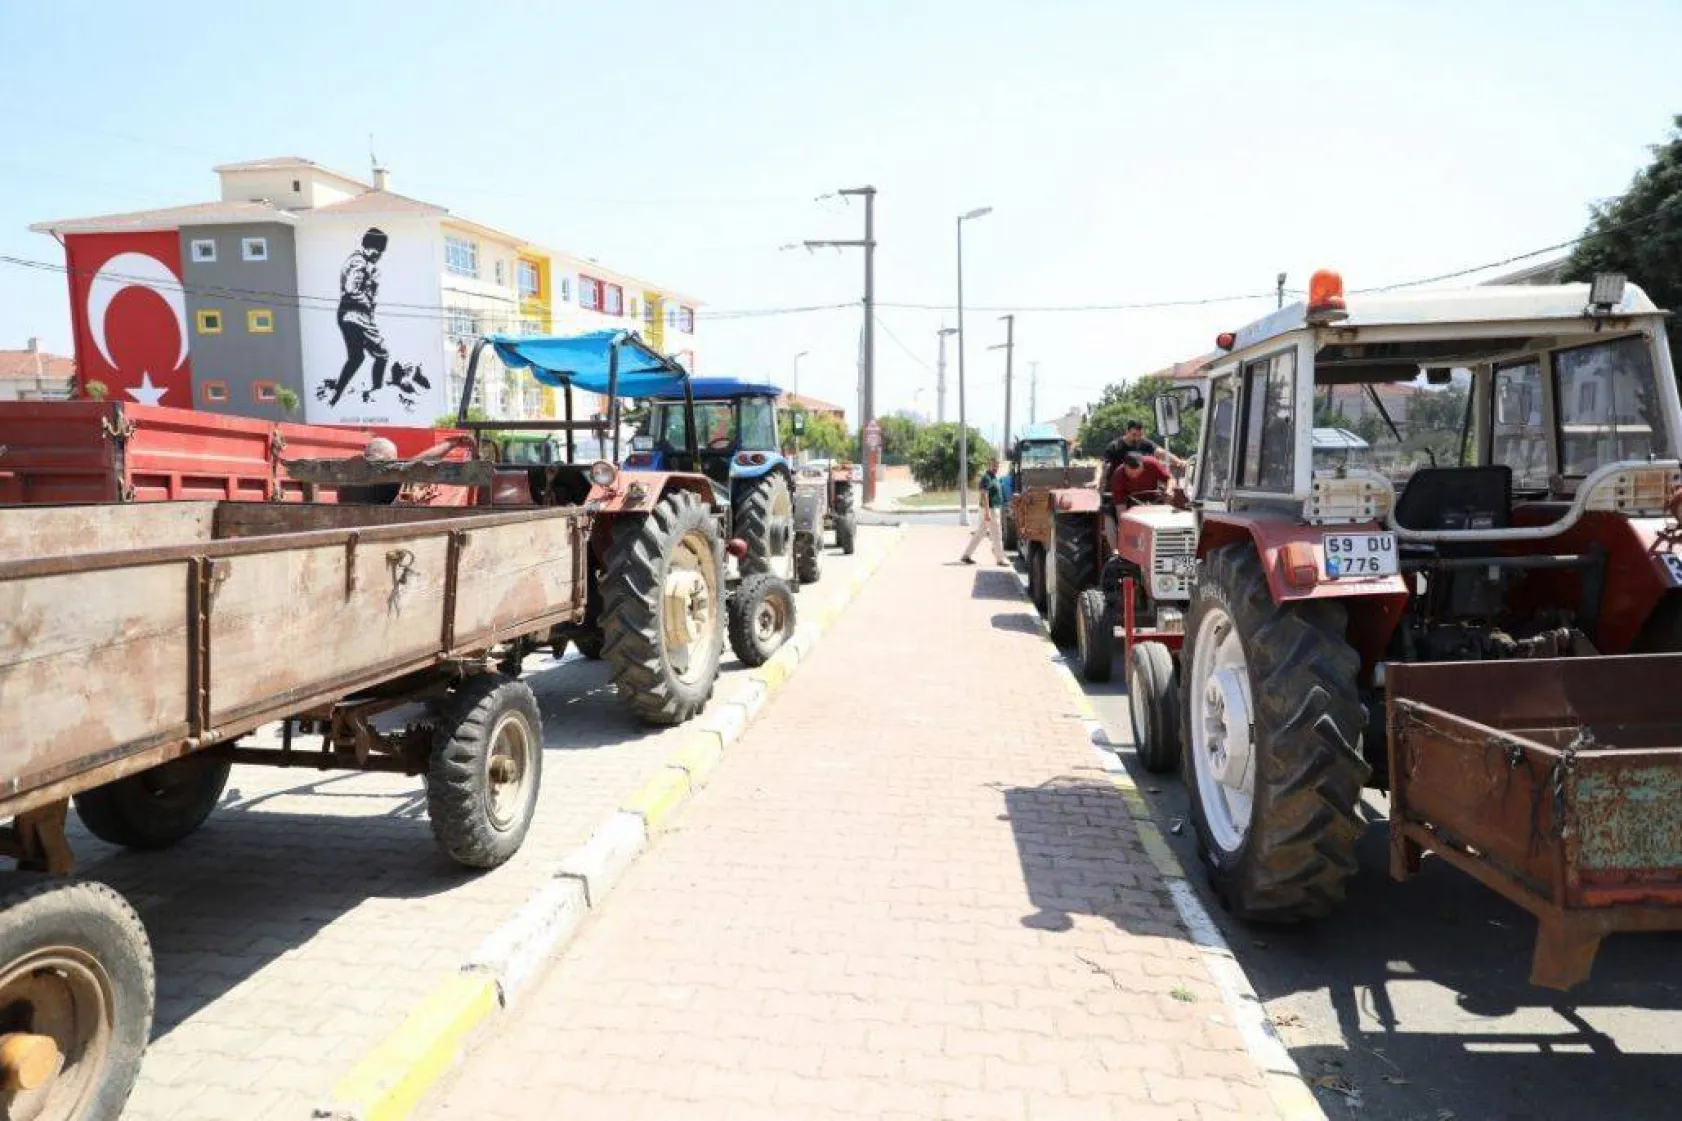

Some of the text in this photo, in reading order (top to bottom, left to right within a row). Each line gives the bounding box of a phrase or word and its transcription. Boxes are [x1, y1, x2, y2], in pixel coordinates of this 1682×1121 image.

[1329, 537, 1391, 552] 59 DU
[1343, 557, 1379, 572] 776
